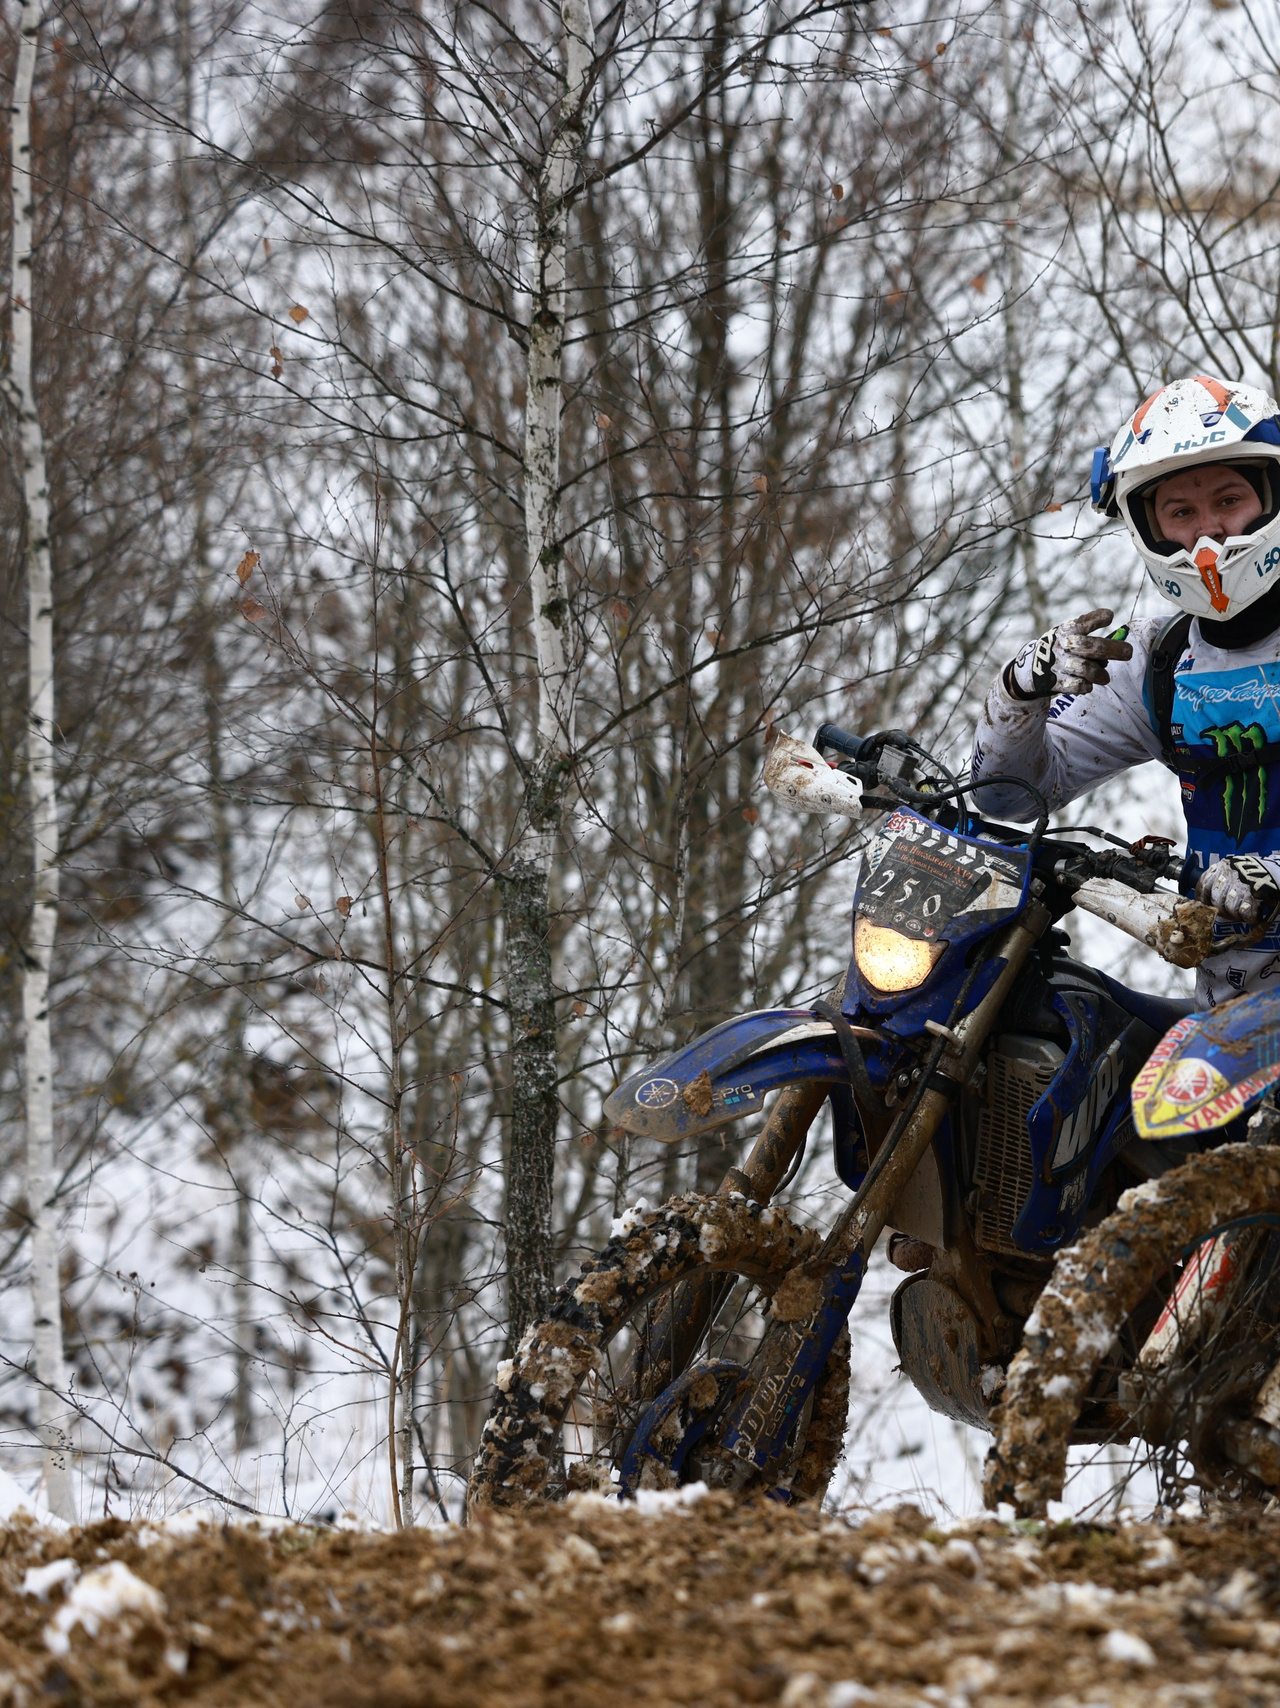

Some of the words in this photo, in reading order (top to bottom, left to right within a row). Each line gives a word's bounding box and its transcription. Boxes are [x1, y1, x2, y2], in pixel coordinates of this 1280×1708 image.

[1173, 430, 1226, 454] HJC
[1233, 855, 1279, 891] FOX
[1132, 1018, 1197, 1102] YAMAHA
